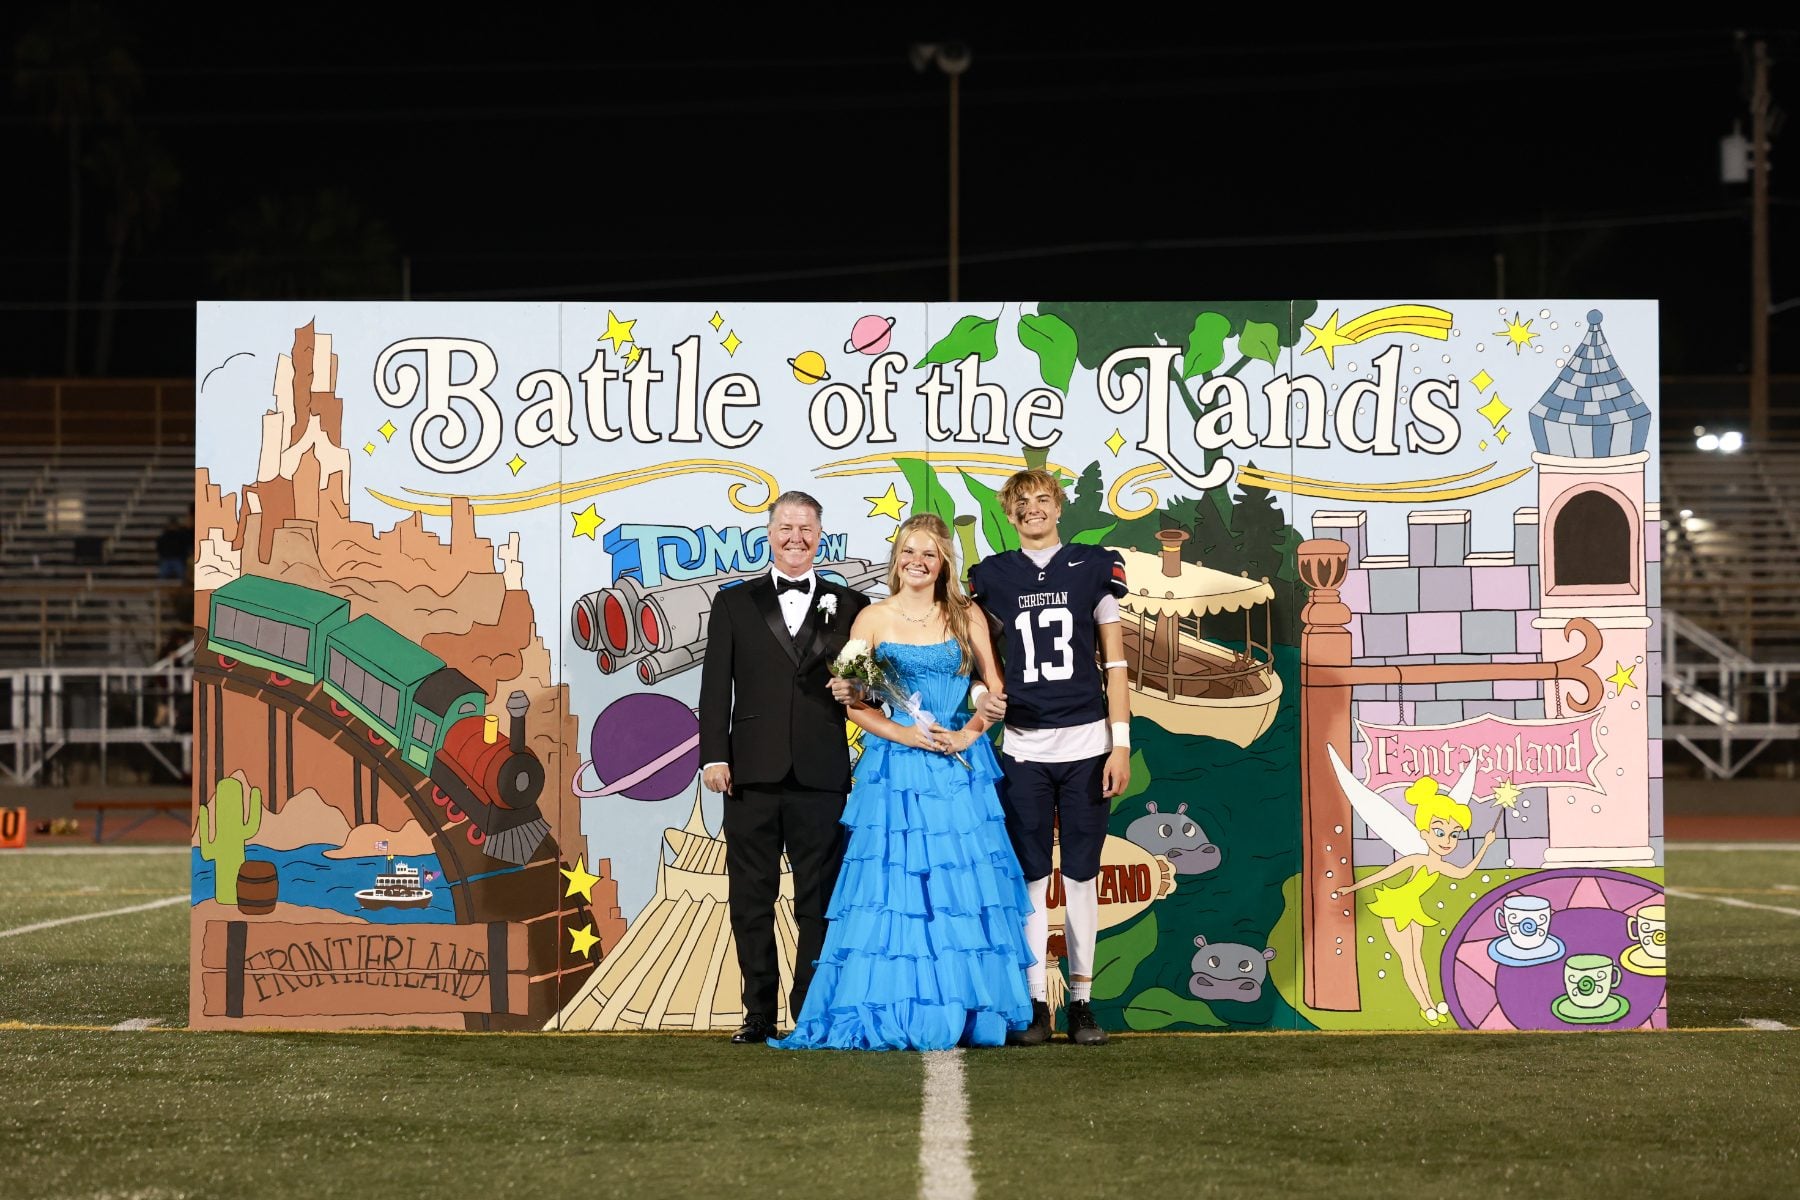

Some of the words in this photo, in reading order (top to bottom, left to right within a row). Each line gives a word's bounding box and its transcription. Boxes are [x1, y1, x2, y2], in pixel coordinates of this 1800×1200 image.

[373, 335, 763, 474] Battle
[808, 352, 908, 449] of
[916, 352, 1064, 448] the
[1097, 344, 1461, 489] Lands
[604, 524, 848, 588] TOMOOW
[1037, 571, 1046, 581] C
[1018, 591, 1069, 609] CHRISTIAN
[1014, 607, 1074, 683] 13
[1376, 729, 1583, 783] Fantasyland
[245, 934, 488, 1002] FRONTIERLAND
